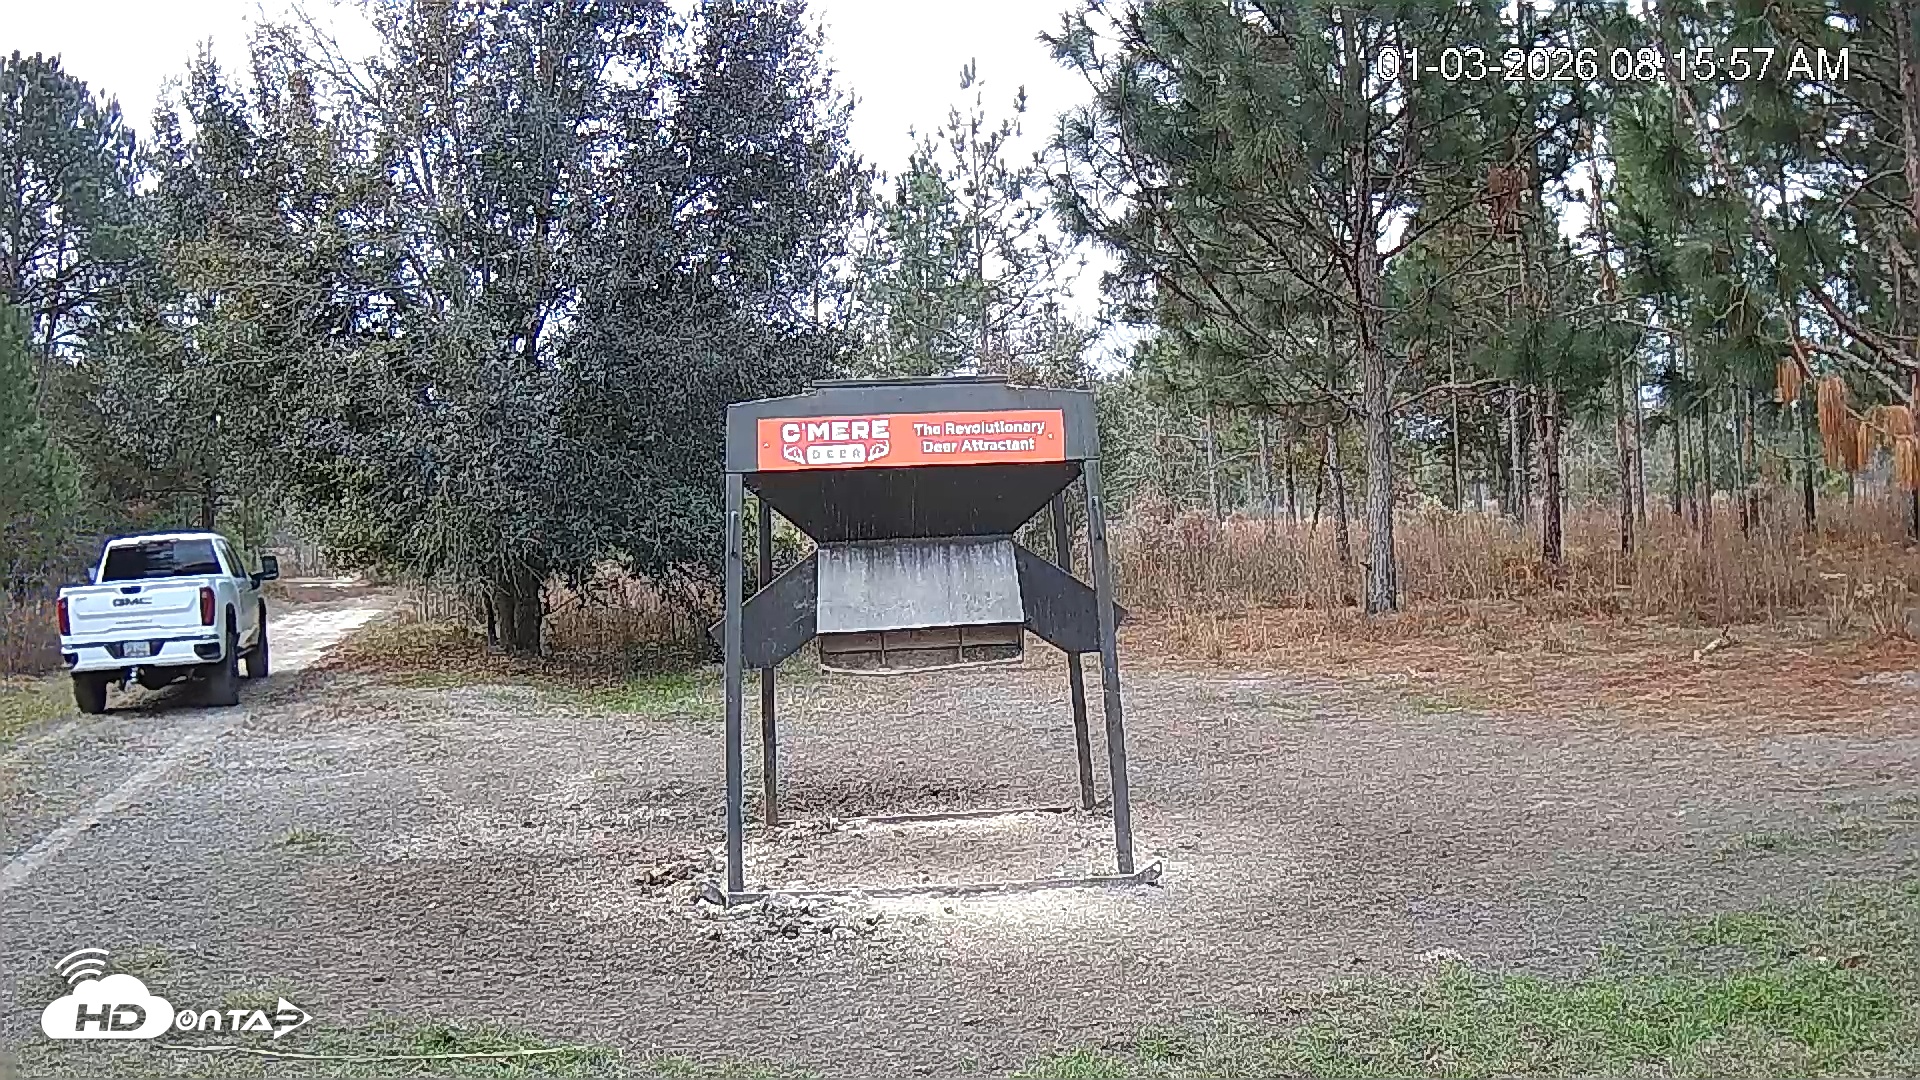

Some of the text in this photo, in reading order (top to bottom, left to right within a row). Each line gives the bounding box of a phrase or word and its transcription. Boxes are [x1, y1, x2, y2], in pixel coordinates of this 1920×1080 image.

[781, 419, 890, 442] C'MERE
[913, 420, 1045, 436] The Revolutionary
[922, 437, 1035, 453] Deer Attractant
[812, 448, 862, 461] DEER
[112, 597, 153, 607] GMC
